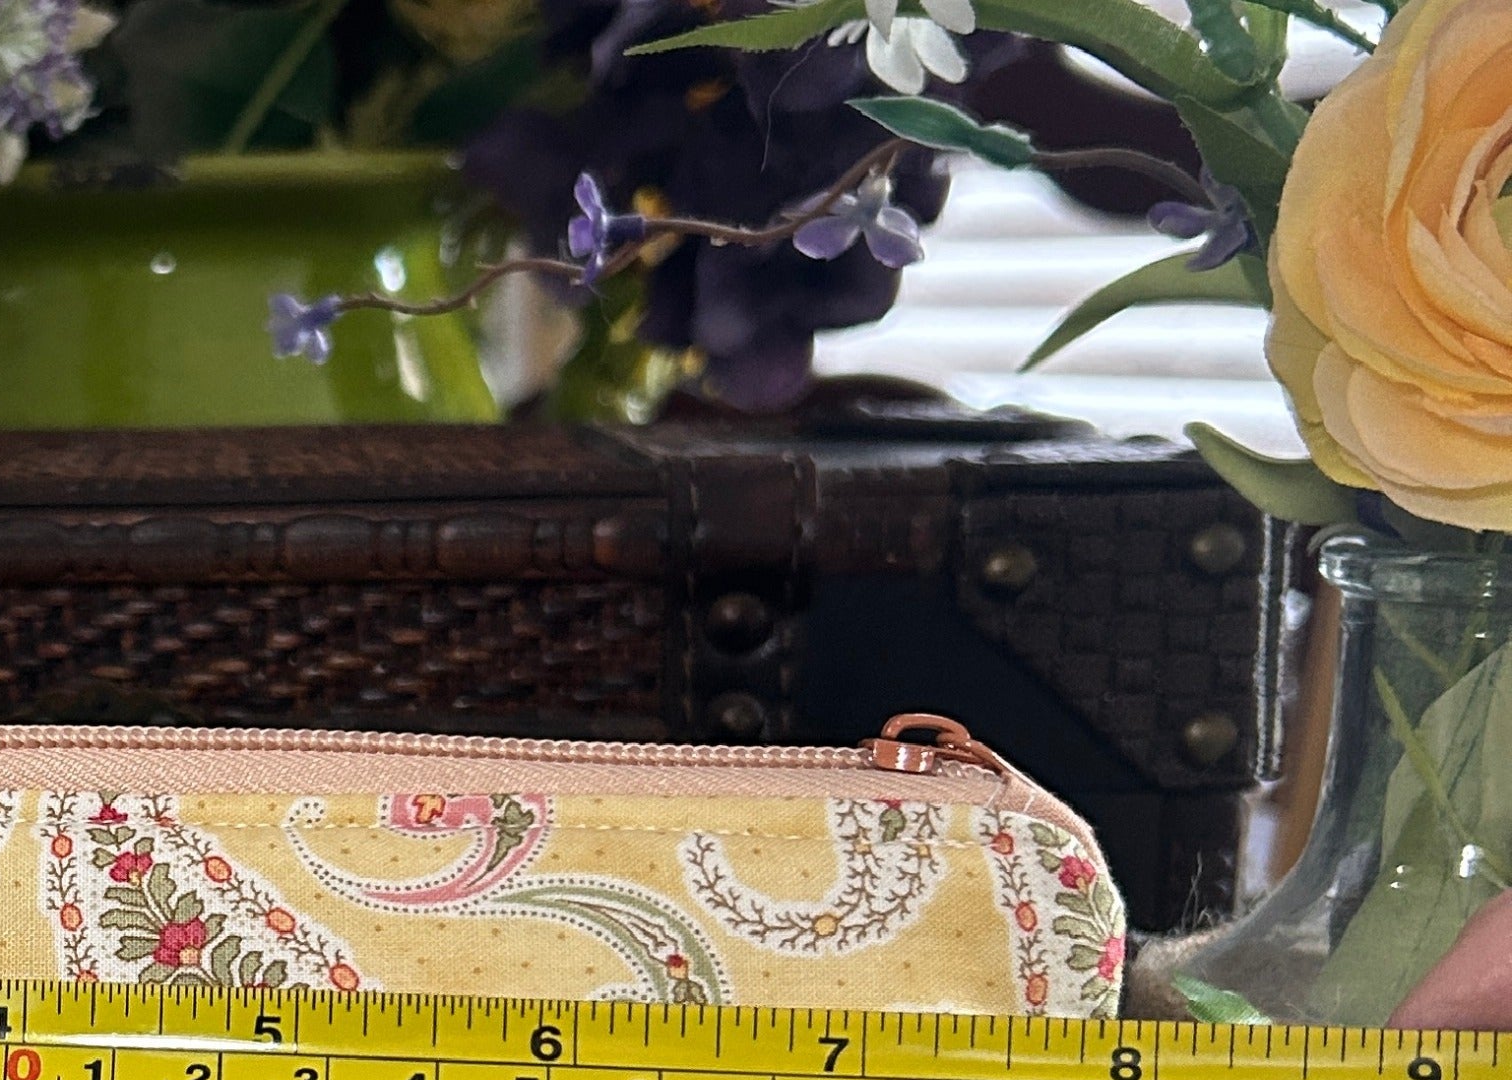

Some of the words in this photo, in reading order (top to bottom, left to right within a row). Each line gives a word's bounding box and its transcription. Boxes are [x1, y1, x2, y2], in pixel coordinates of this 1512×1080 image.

[254, 1016, 283, 1049] 5
[530, 1025, 563, 1060] 6
[817, 1036, 850, 1071] 7
